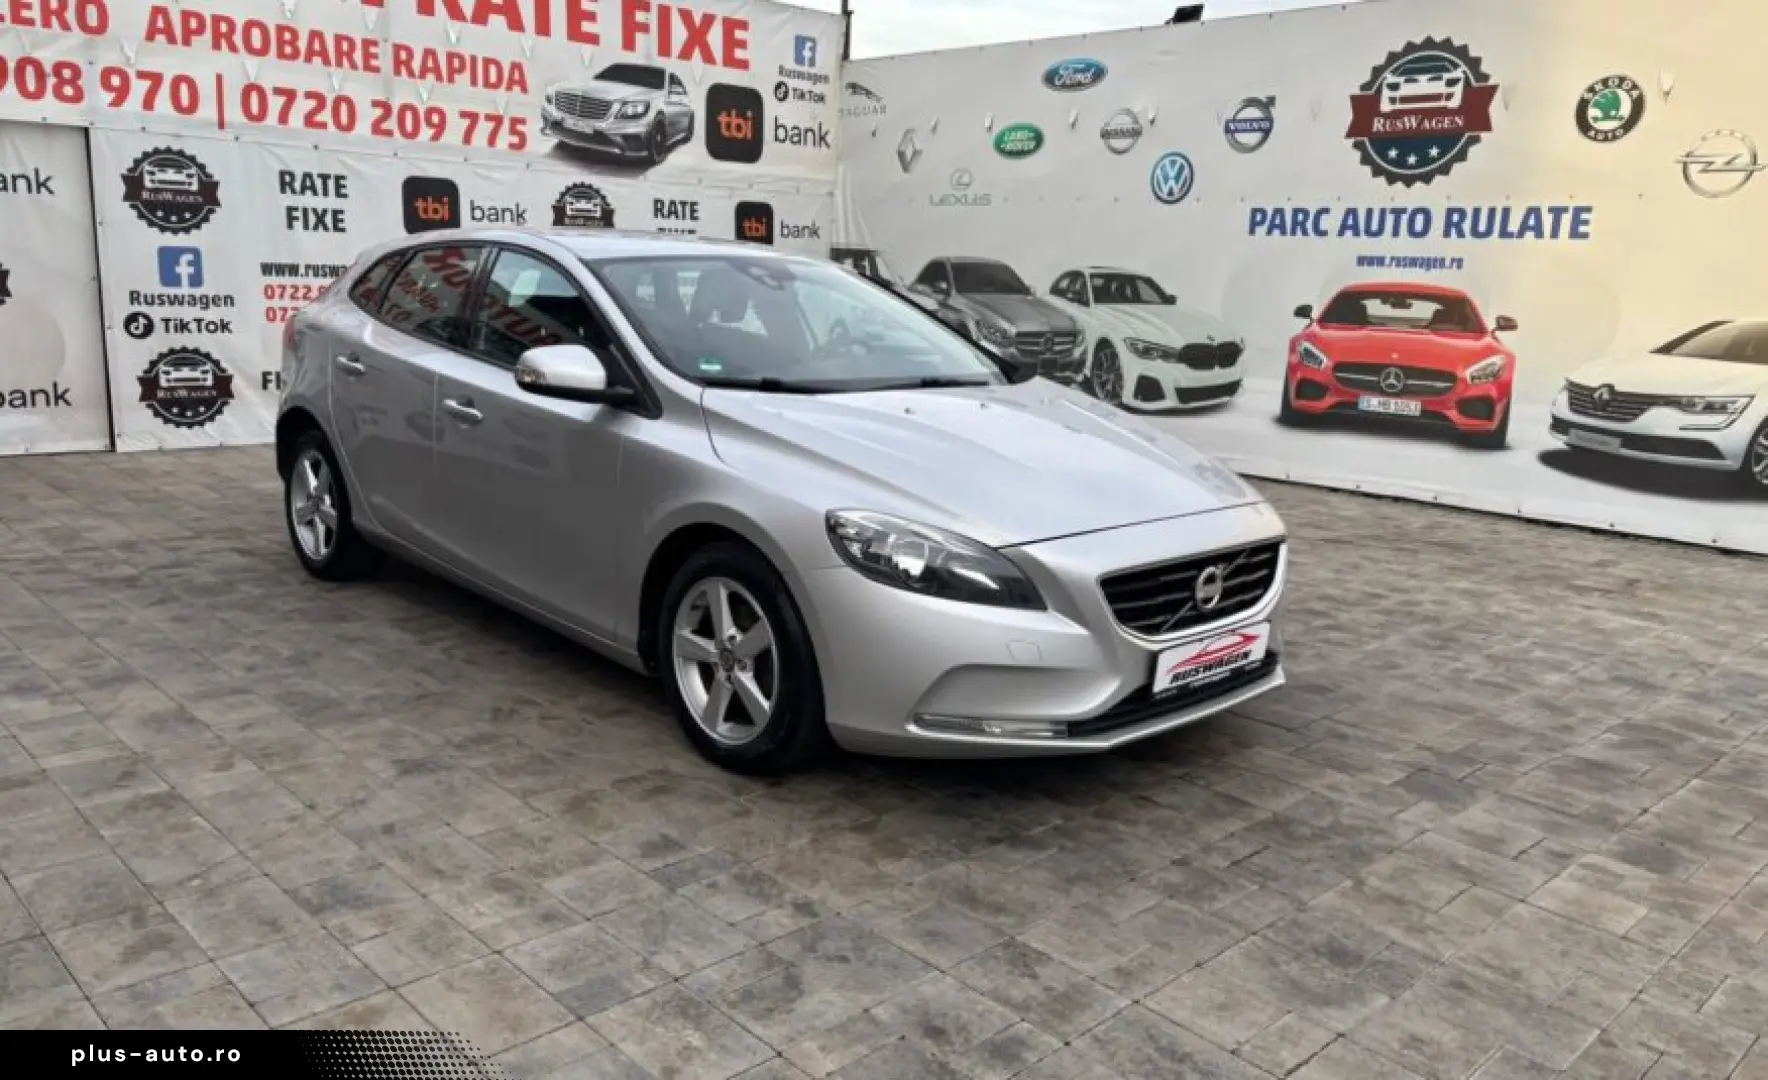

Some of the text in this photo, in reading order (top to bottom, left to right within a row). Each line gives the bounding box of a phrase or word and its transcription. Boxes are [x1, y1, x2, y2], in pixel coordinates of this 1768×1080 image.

[144, 5, 382, 74] APROBARE
[391, 42, 528, 94] RAPIDA
[620, 0, 750, 72] FIXE
[0, 55, 85, 104] 08
[100, 66, 200, 116] 970
[240, 82, 357, 133] 0720
[371, 99, 447, 142] 209
[459, 110, 527, 151] 775
[717, 109, 831, 149] tbi bank
[278, 169, 349, 199] RATE
[286, 205, 347, 233] FIXE
[416, 196, 528, 227] tbi bank
[653, 198, 700, 221] RATE
[1248, 205, 1593, 239] PARC AUTO RULATE
[780, 219, 821, 240] bank
[128, 289, 236, 310] Ruswagen
[160, 317, 234, 335] TikTok
